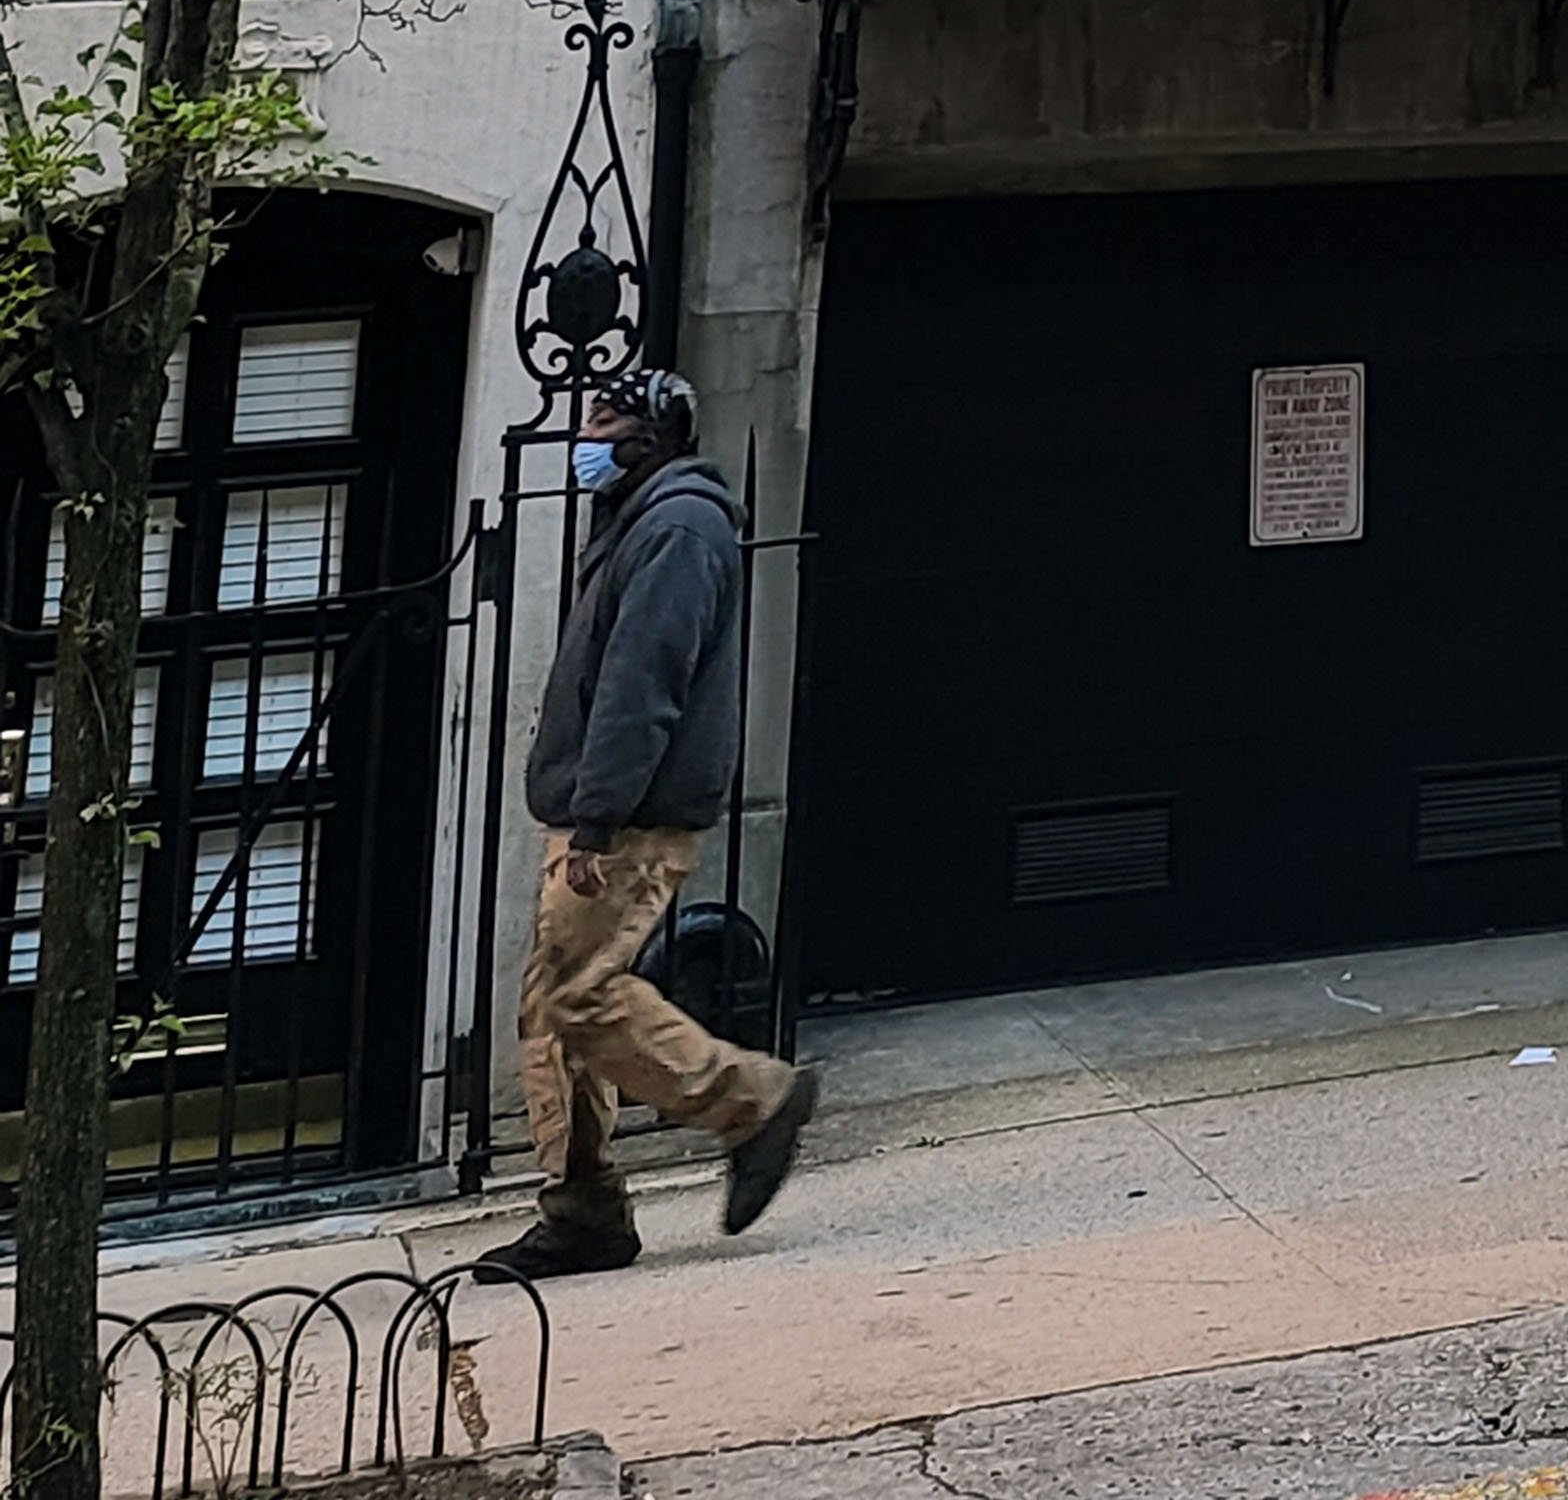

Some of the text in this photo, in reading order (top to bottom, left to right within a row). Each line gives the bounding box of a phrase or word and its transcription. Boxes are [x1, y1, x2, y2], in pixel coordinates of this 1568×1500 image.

[1265, 376, 1351, 396] PRIVATE PROPERTY
[1265, 394, 1351, 415] TOW AWAY ZONE
